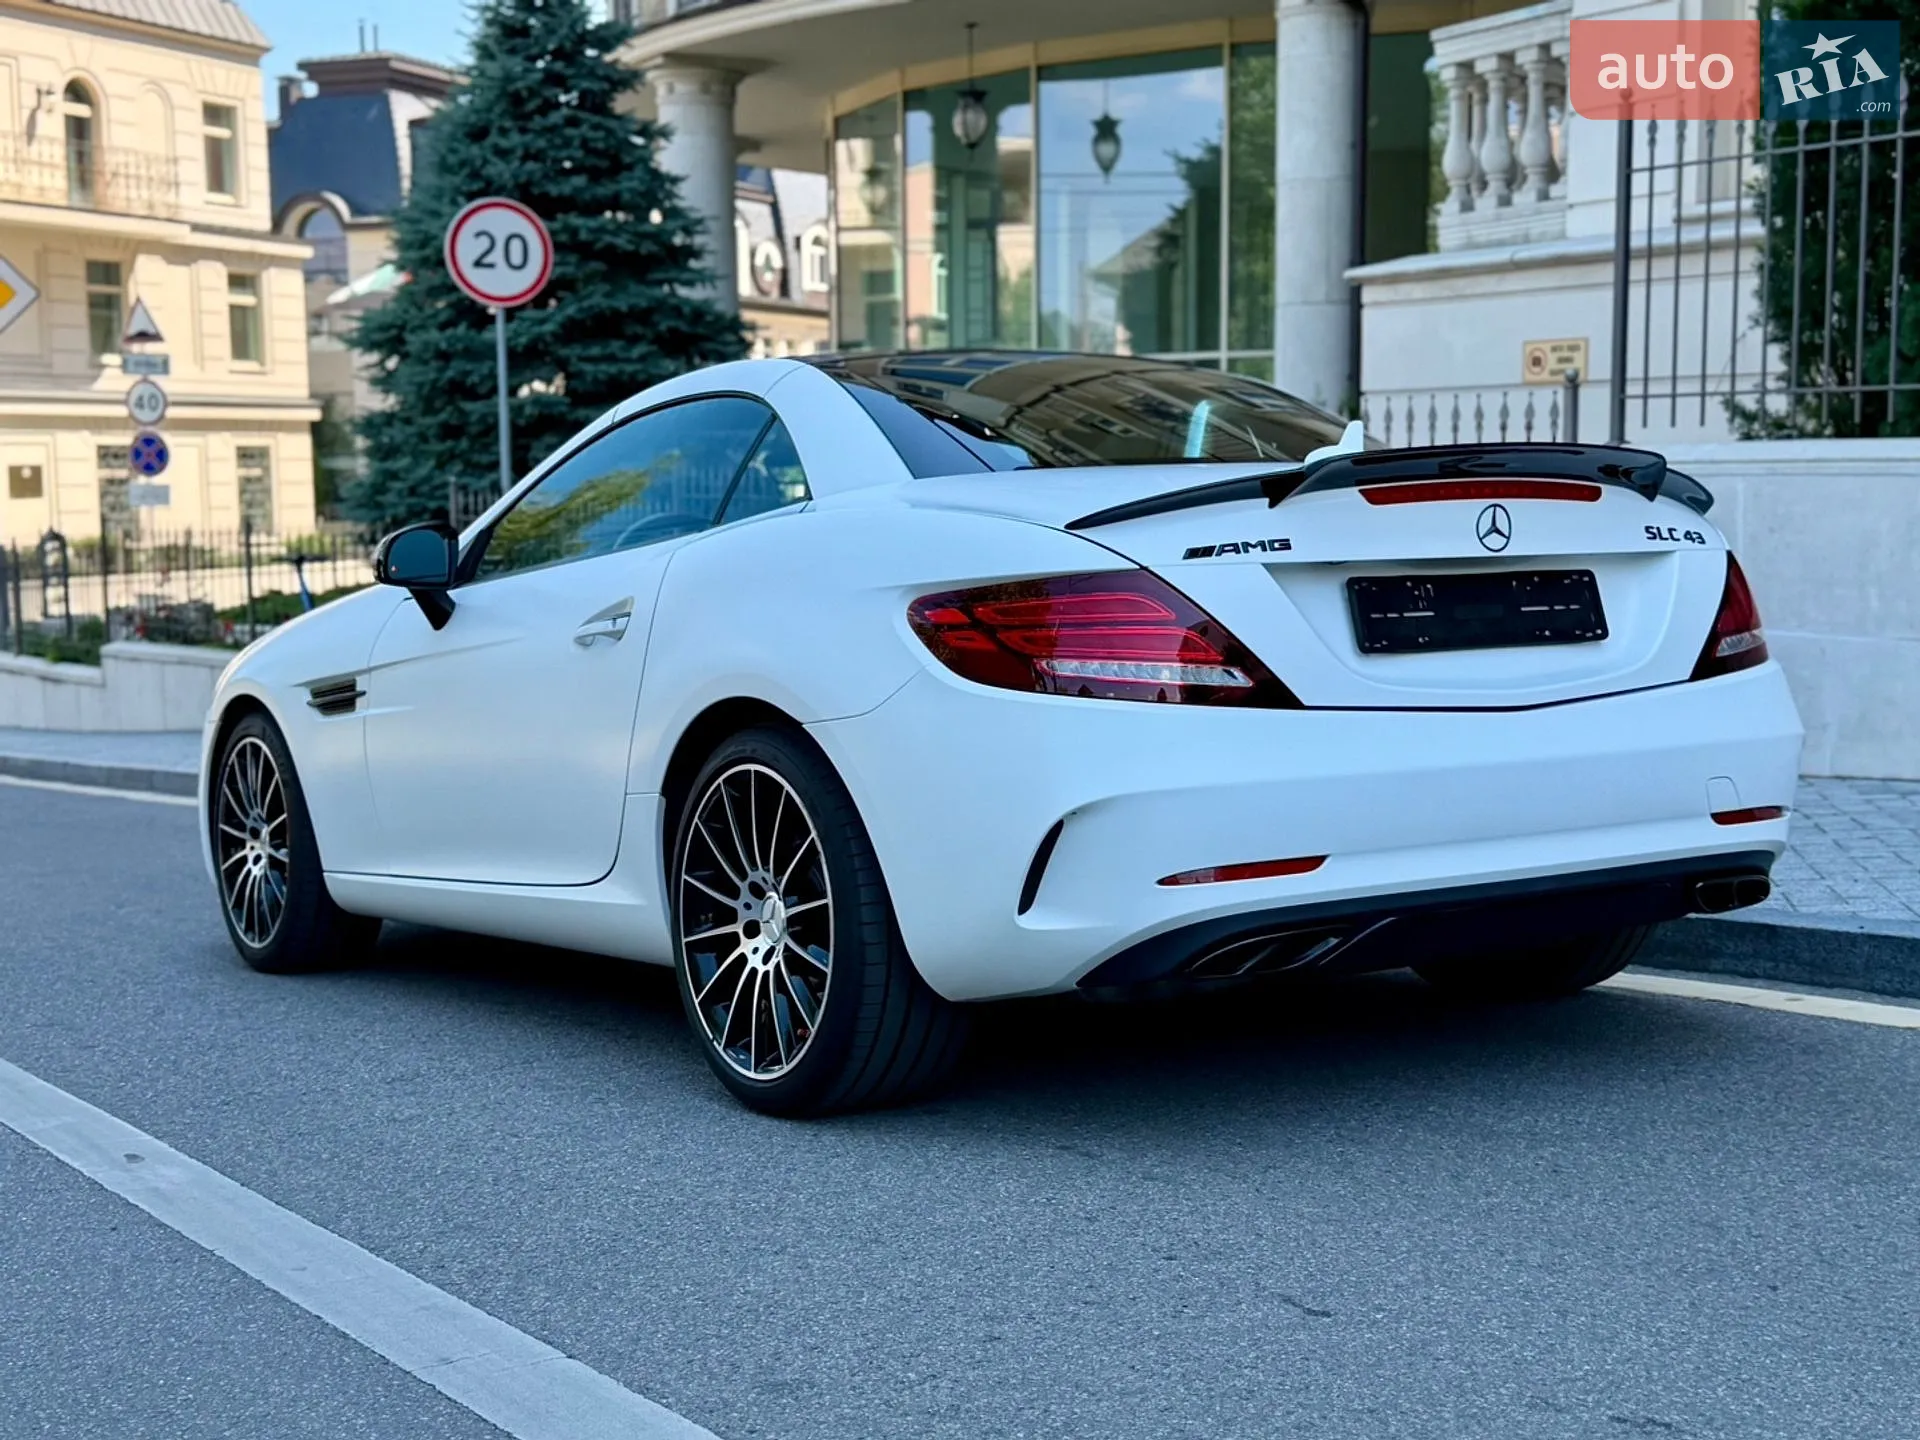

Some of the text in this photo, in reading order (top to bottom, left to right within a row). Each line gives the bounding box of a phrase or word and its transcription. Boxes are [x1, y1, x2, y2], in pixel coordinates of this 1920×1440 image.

[472, 230, 529, 271] 20
[133, 392, 161, 412] 40
[1644, 525, 1707, 545] SLC 43
[1214, 538, 1292, 557] AMG
